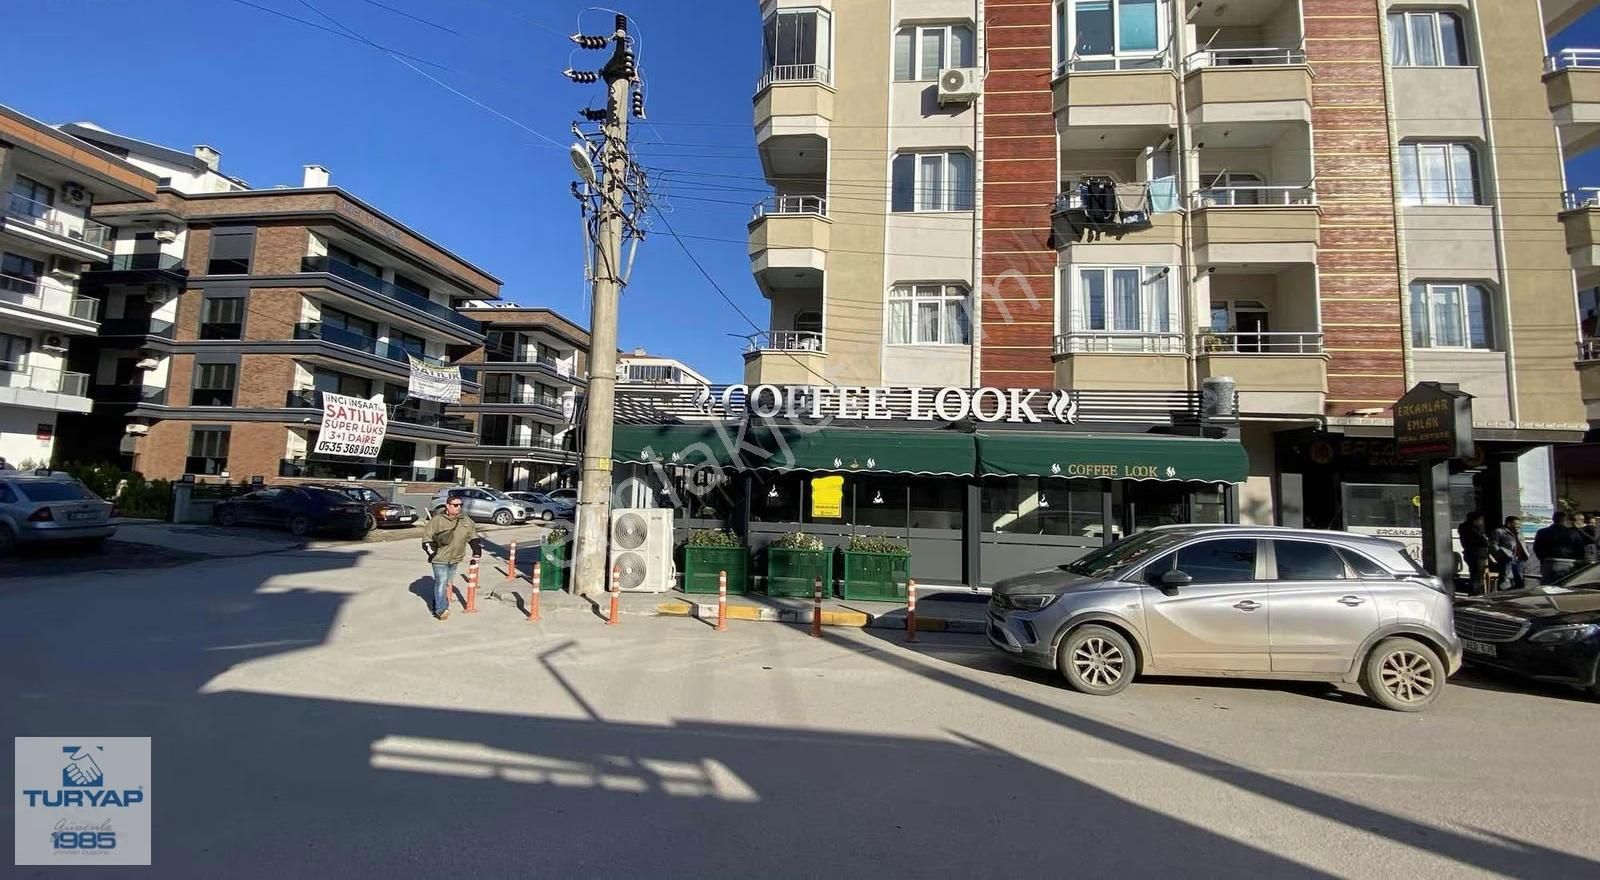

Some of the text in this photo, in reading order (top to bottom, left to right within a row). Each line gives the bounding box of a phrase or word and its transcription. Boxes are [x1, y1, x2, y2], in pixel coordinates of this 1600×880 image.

[721, 383, 1042, 424] COFFEE LOOK
[1397, 399, 1449, 417] ERCANLAR
[326, 404, 385, 426] SATILIK
[1407, 416, 1439, 430] EMLAK
[328, 430, 346, 441] 3+1
[318, 440, 343, 453] 0535
[1068, 464, 1158, 477] COFFEE LOOK
